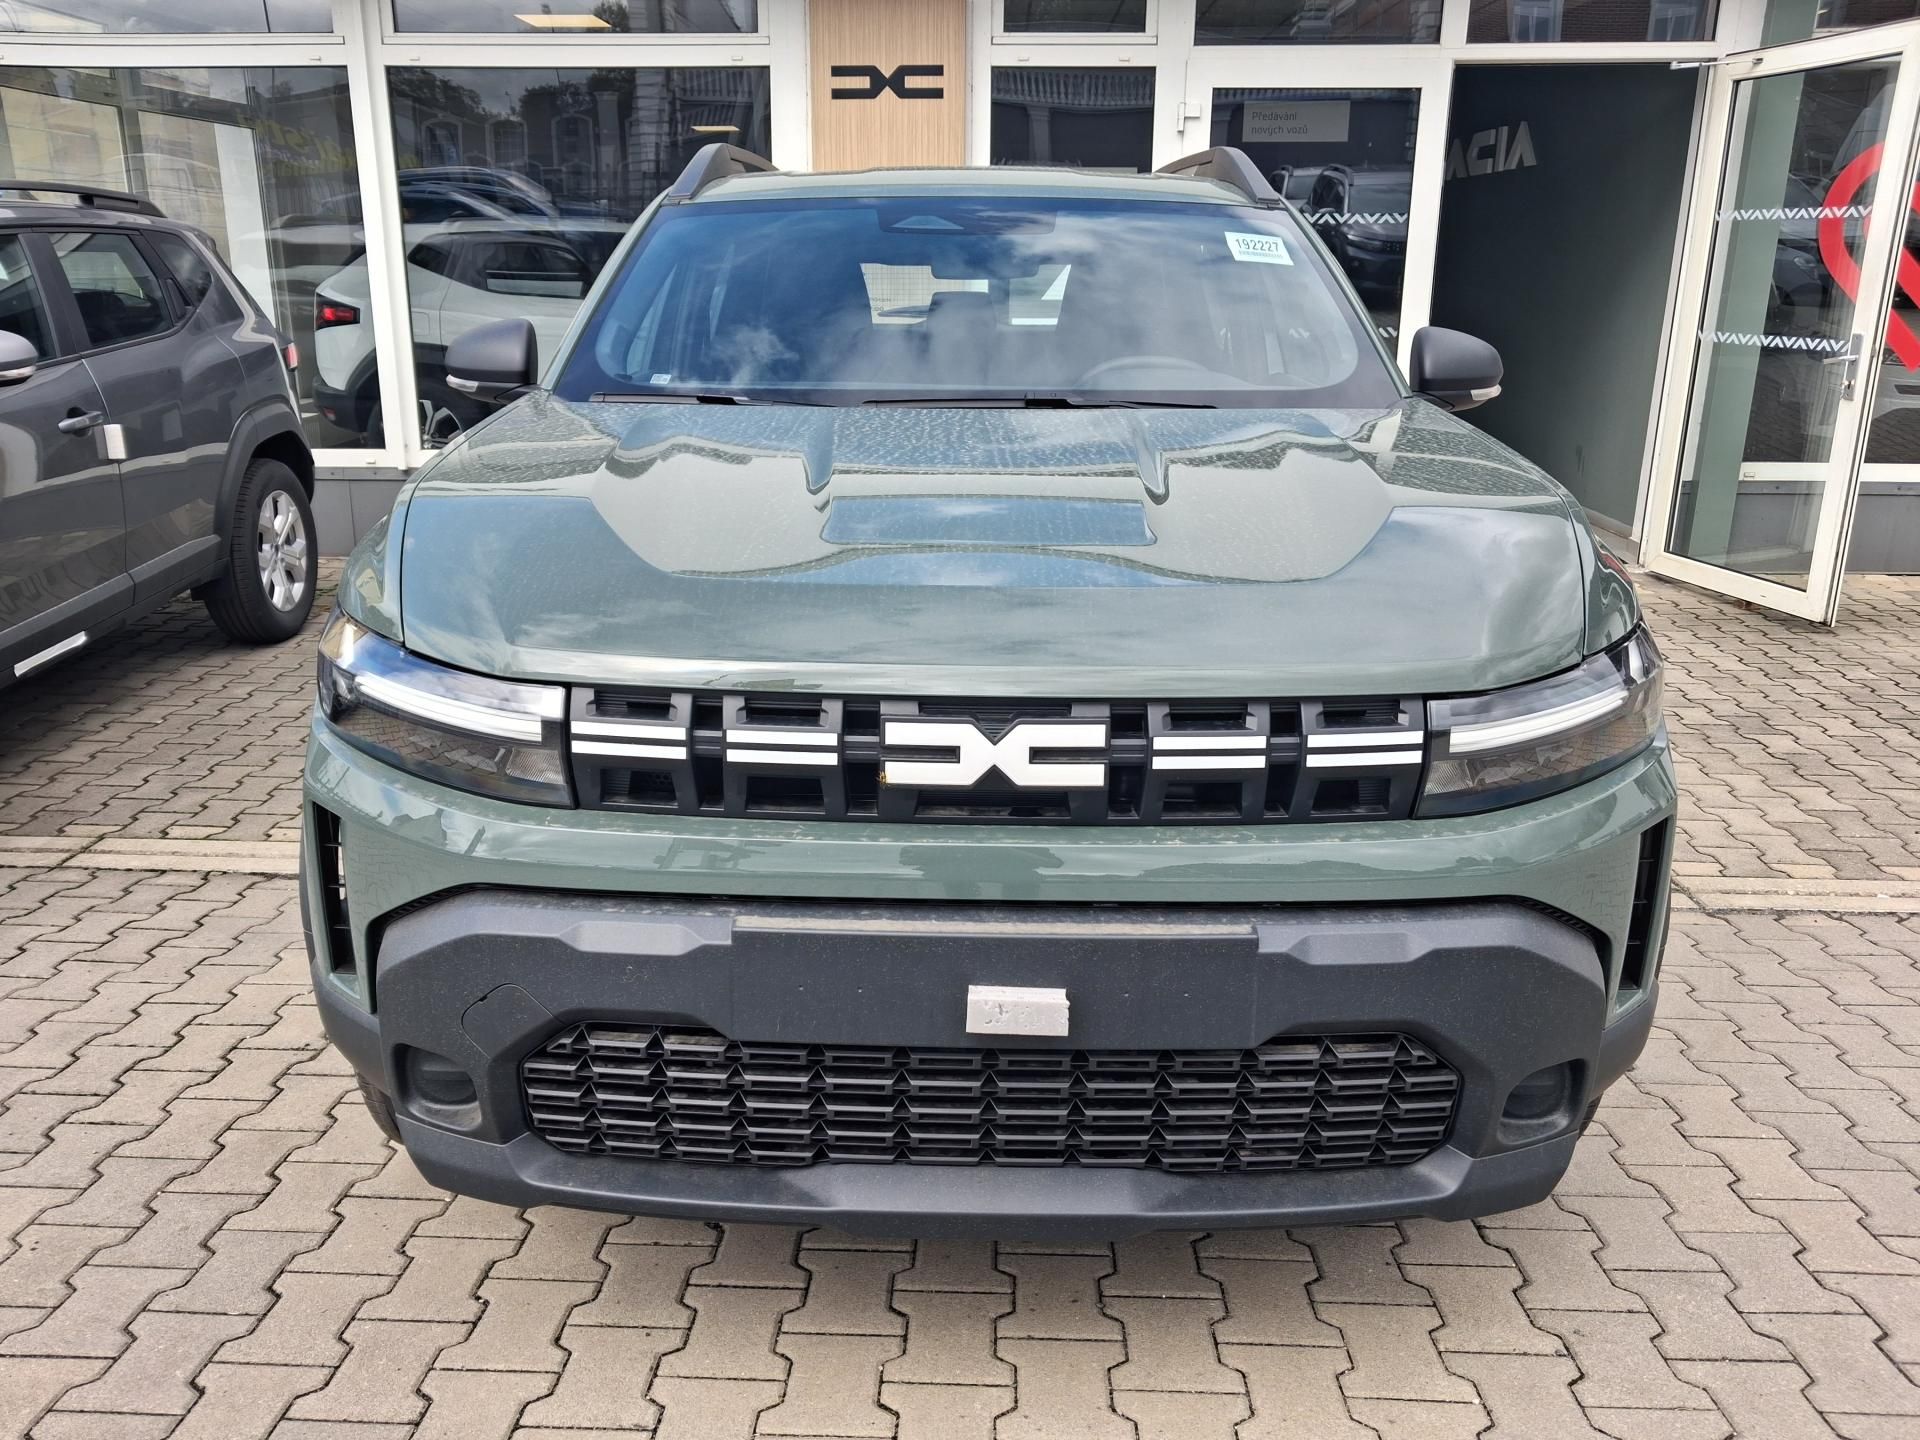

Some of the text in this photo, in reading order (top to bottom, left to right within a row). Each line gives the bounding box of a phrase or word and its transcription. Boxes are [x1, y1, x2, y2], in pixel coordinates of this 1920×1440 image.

[1251, 110, 1297, 121] Předávání
[1251, 124, 1308, 137] nových vozů
[1235, 238, 1280, 252] 192227
